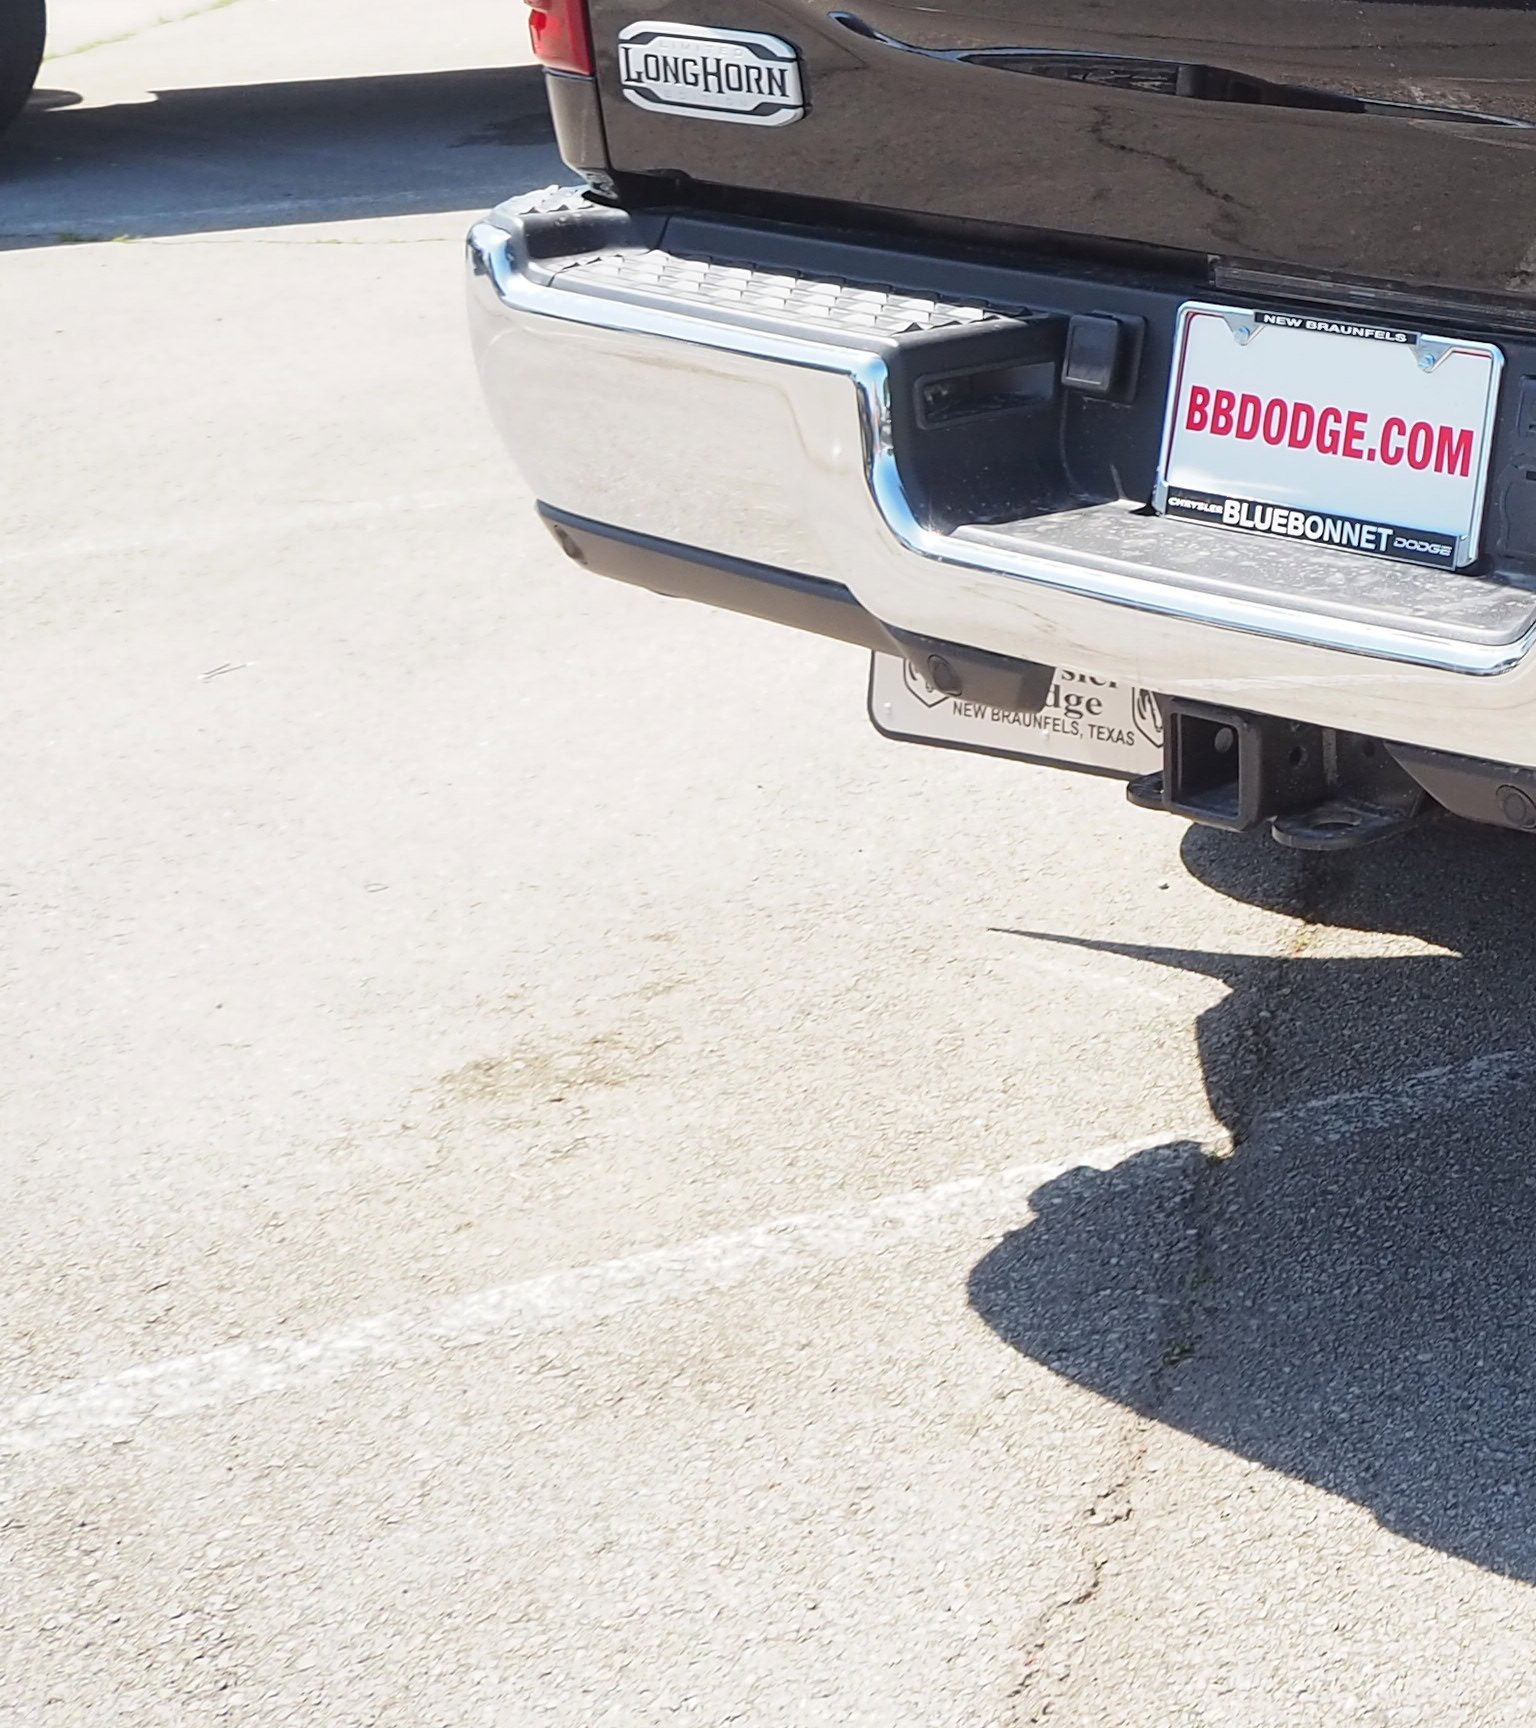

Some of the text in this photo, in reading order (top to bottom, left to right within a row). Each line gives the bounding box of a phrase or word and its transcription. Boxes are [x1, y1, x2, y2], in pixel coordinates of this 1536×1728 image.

[1263, 313, 1408, 343] NEW BRAUNFELS
[1185, 384, 1475, 478] BBDODGE.COM
[1167, 496, 1453, 557] CHRYSLER BLUEBONNET DODGE
[952, 700, 1135, 747] NEW BRAUNFELS, TEXAS
[1045, 683, 1103, 720] dge
